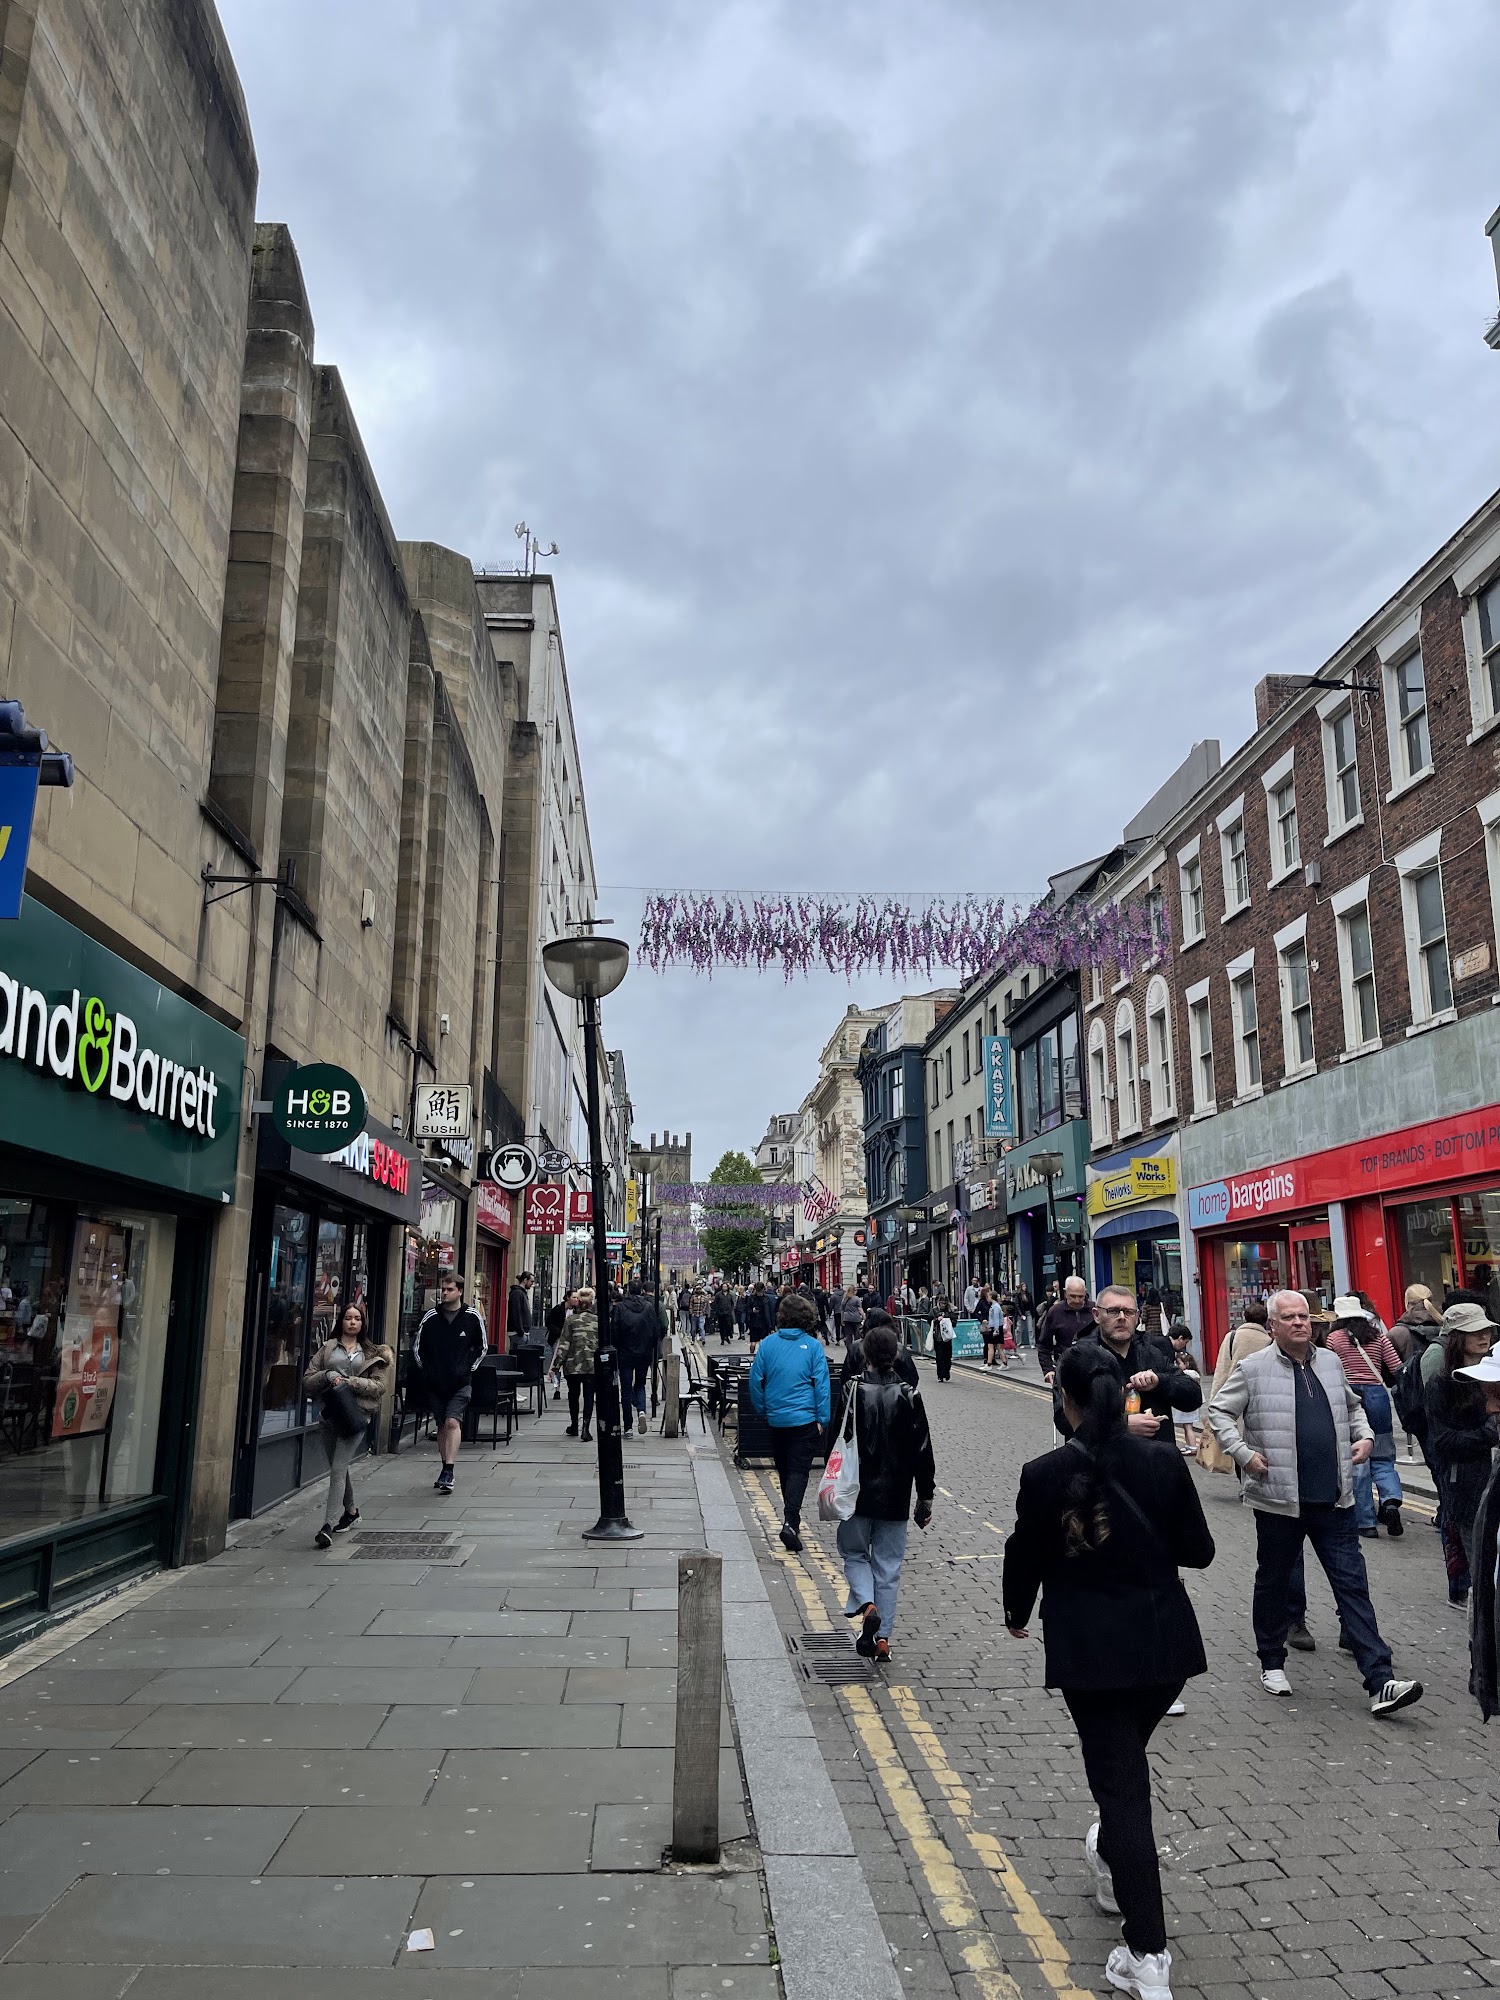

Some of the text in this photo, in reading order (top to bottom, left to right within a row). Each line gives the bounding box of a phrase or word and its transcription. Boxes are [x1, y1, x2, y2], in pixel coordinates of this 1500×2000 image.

[110, 1012, 218, 1139] Barrett
[991, 1041, 1006, 1122] AKASYA
[287, 1088, 351, 1116] H&B
[425, 1089, 461, 1123] 鮨
[286, 1119, 349, 1129] SINCE 1870
[421, 1125, 461, 1134] SUSHI
[1382, 1144, 1425, 1169] BRANDS
[1435, 1129, 1486, 1158] BOTTOM
[373, 1138, 409, 1196] SUSHI
[1016, 1162, 1063, 1192] AKA
[1136, 1171, 1166, 1181] Works
[1142, 1162, 1160, 1171] The
[1198, 1169, 1295, 1216] home bargains
